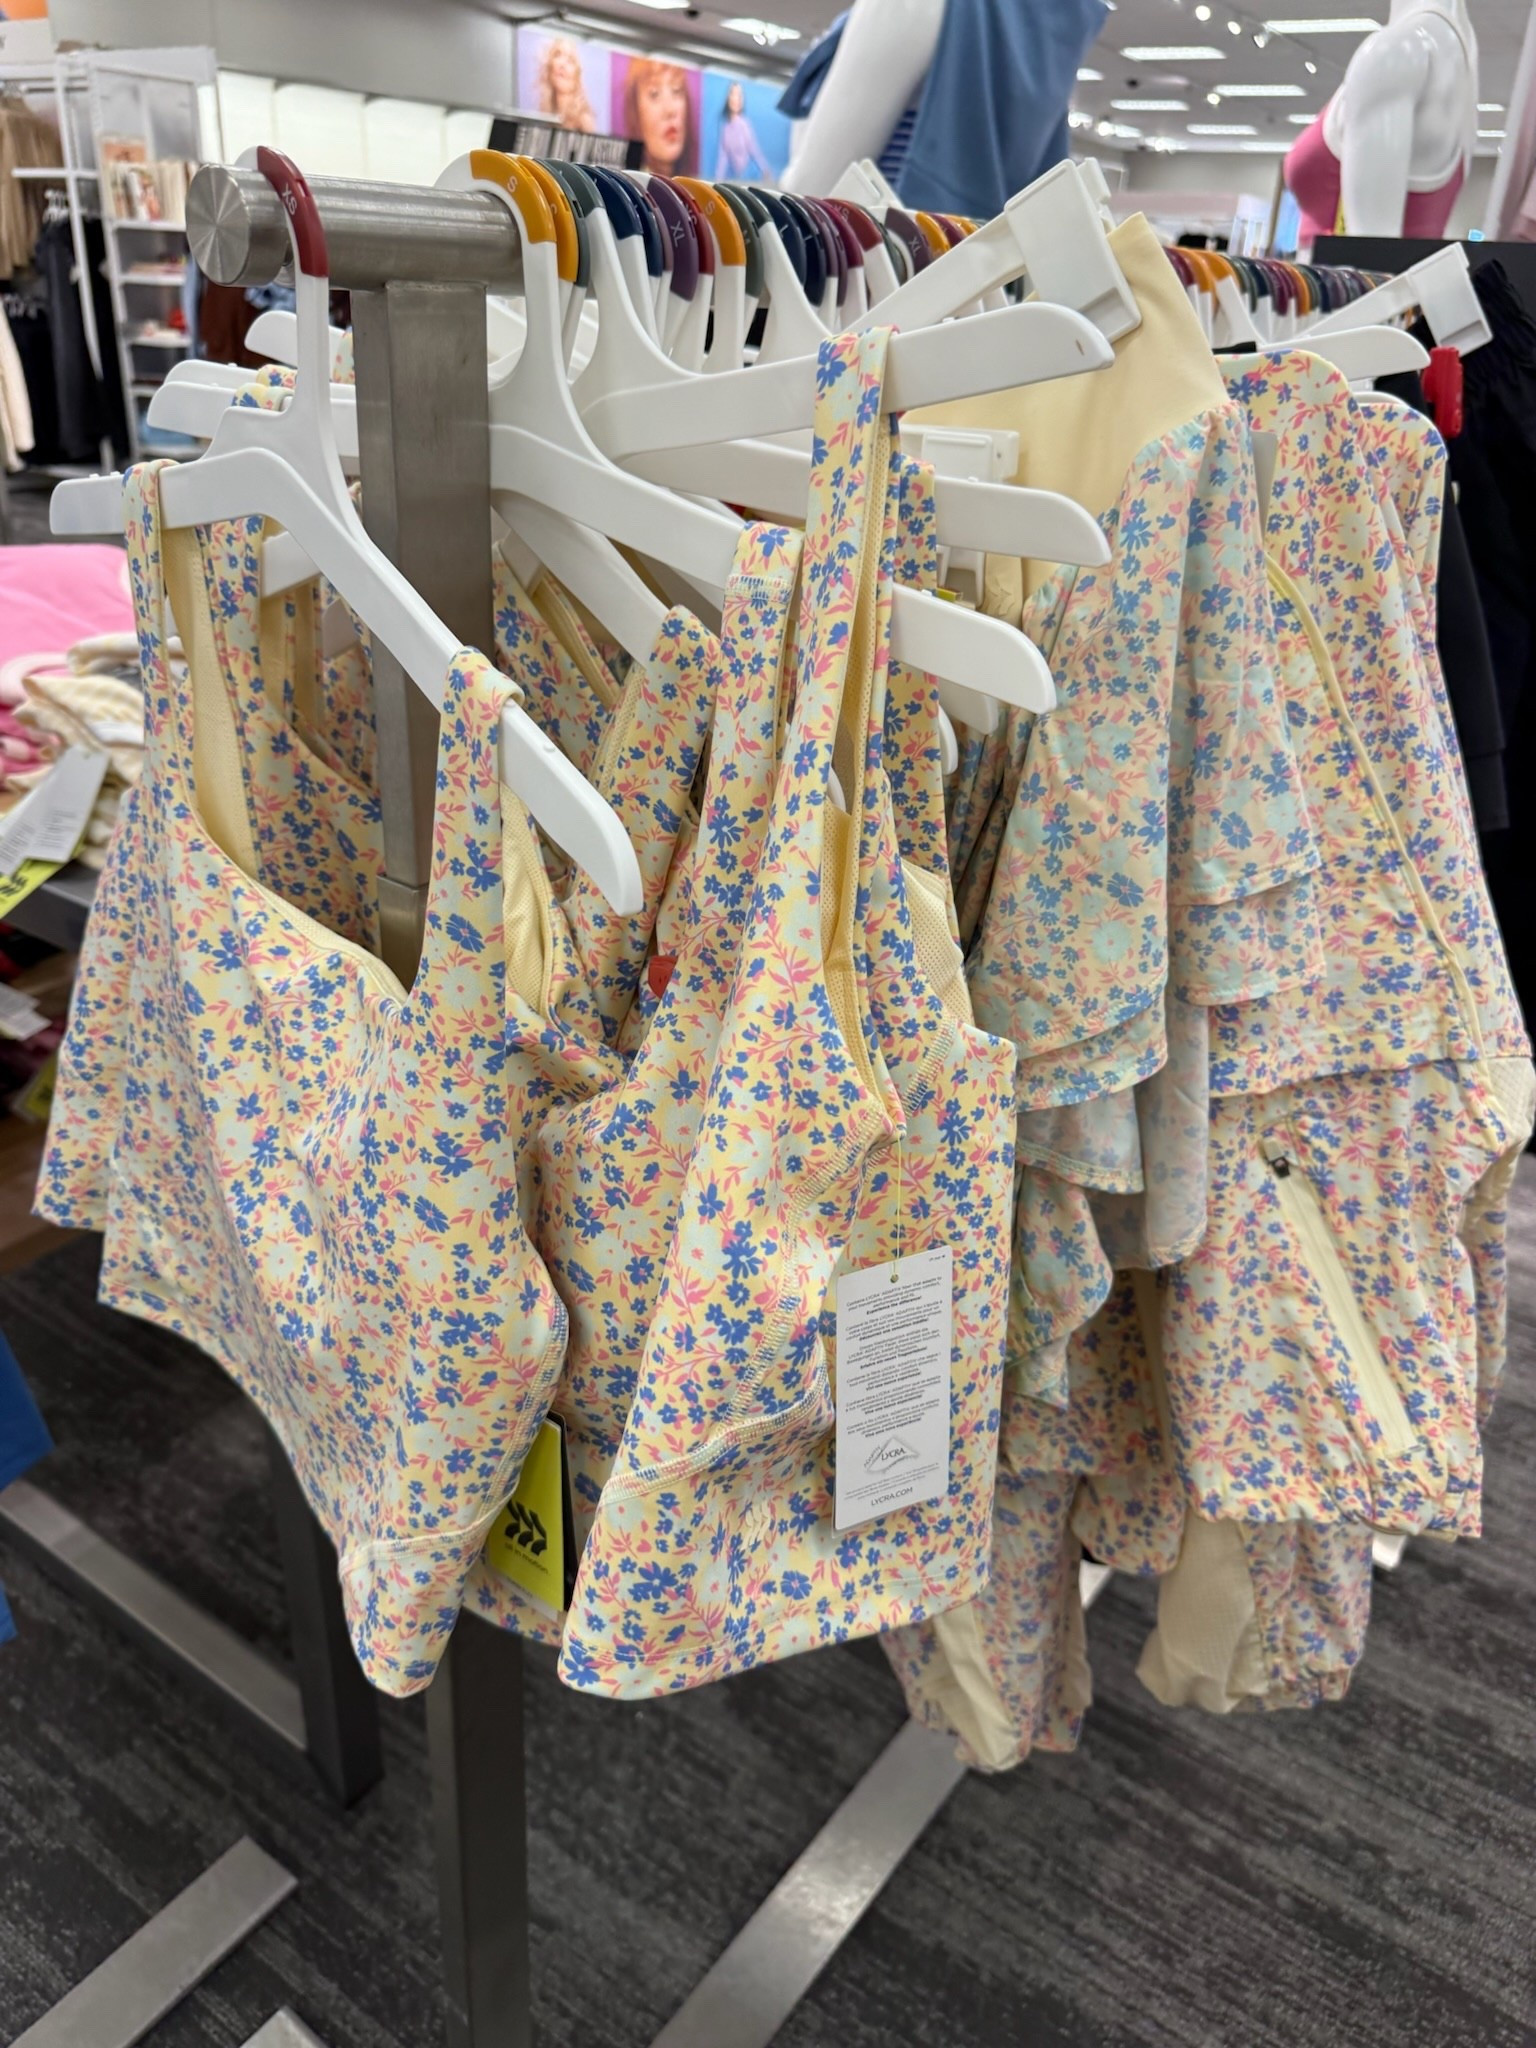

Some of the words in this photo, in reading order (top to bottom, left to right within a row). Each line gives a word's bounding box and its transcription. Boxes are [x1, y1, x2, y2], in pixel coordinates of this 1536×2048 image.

[506, 175, 518, 193] S
[281, 183, 298, 216] XS
[705, 200, 716, 217] S
[670, 220, 686, 248] XL
[908, 236, 921, 258] XL
[881, 1446, 905, 1461] LYCRA
[871, 1486, 912, 1506] LYCRA.COM
